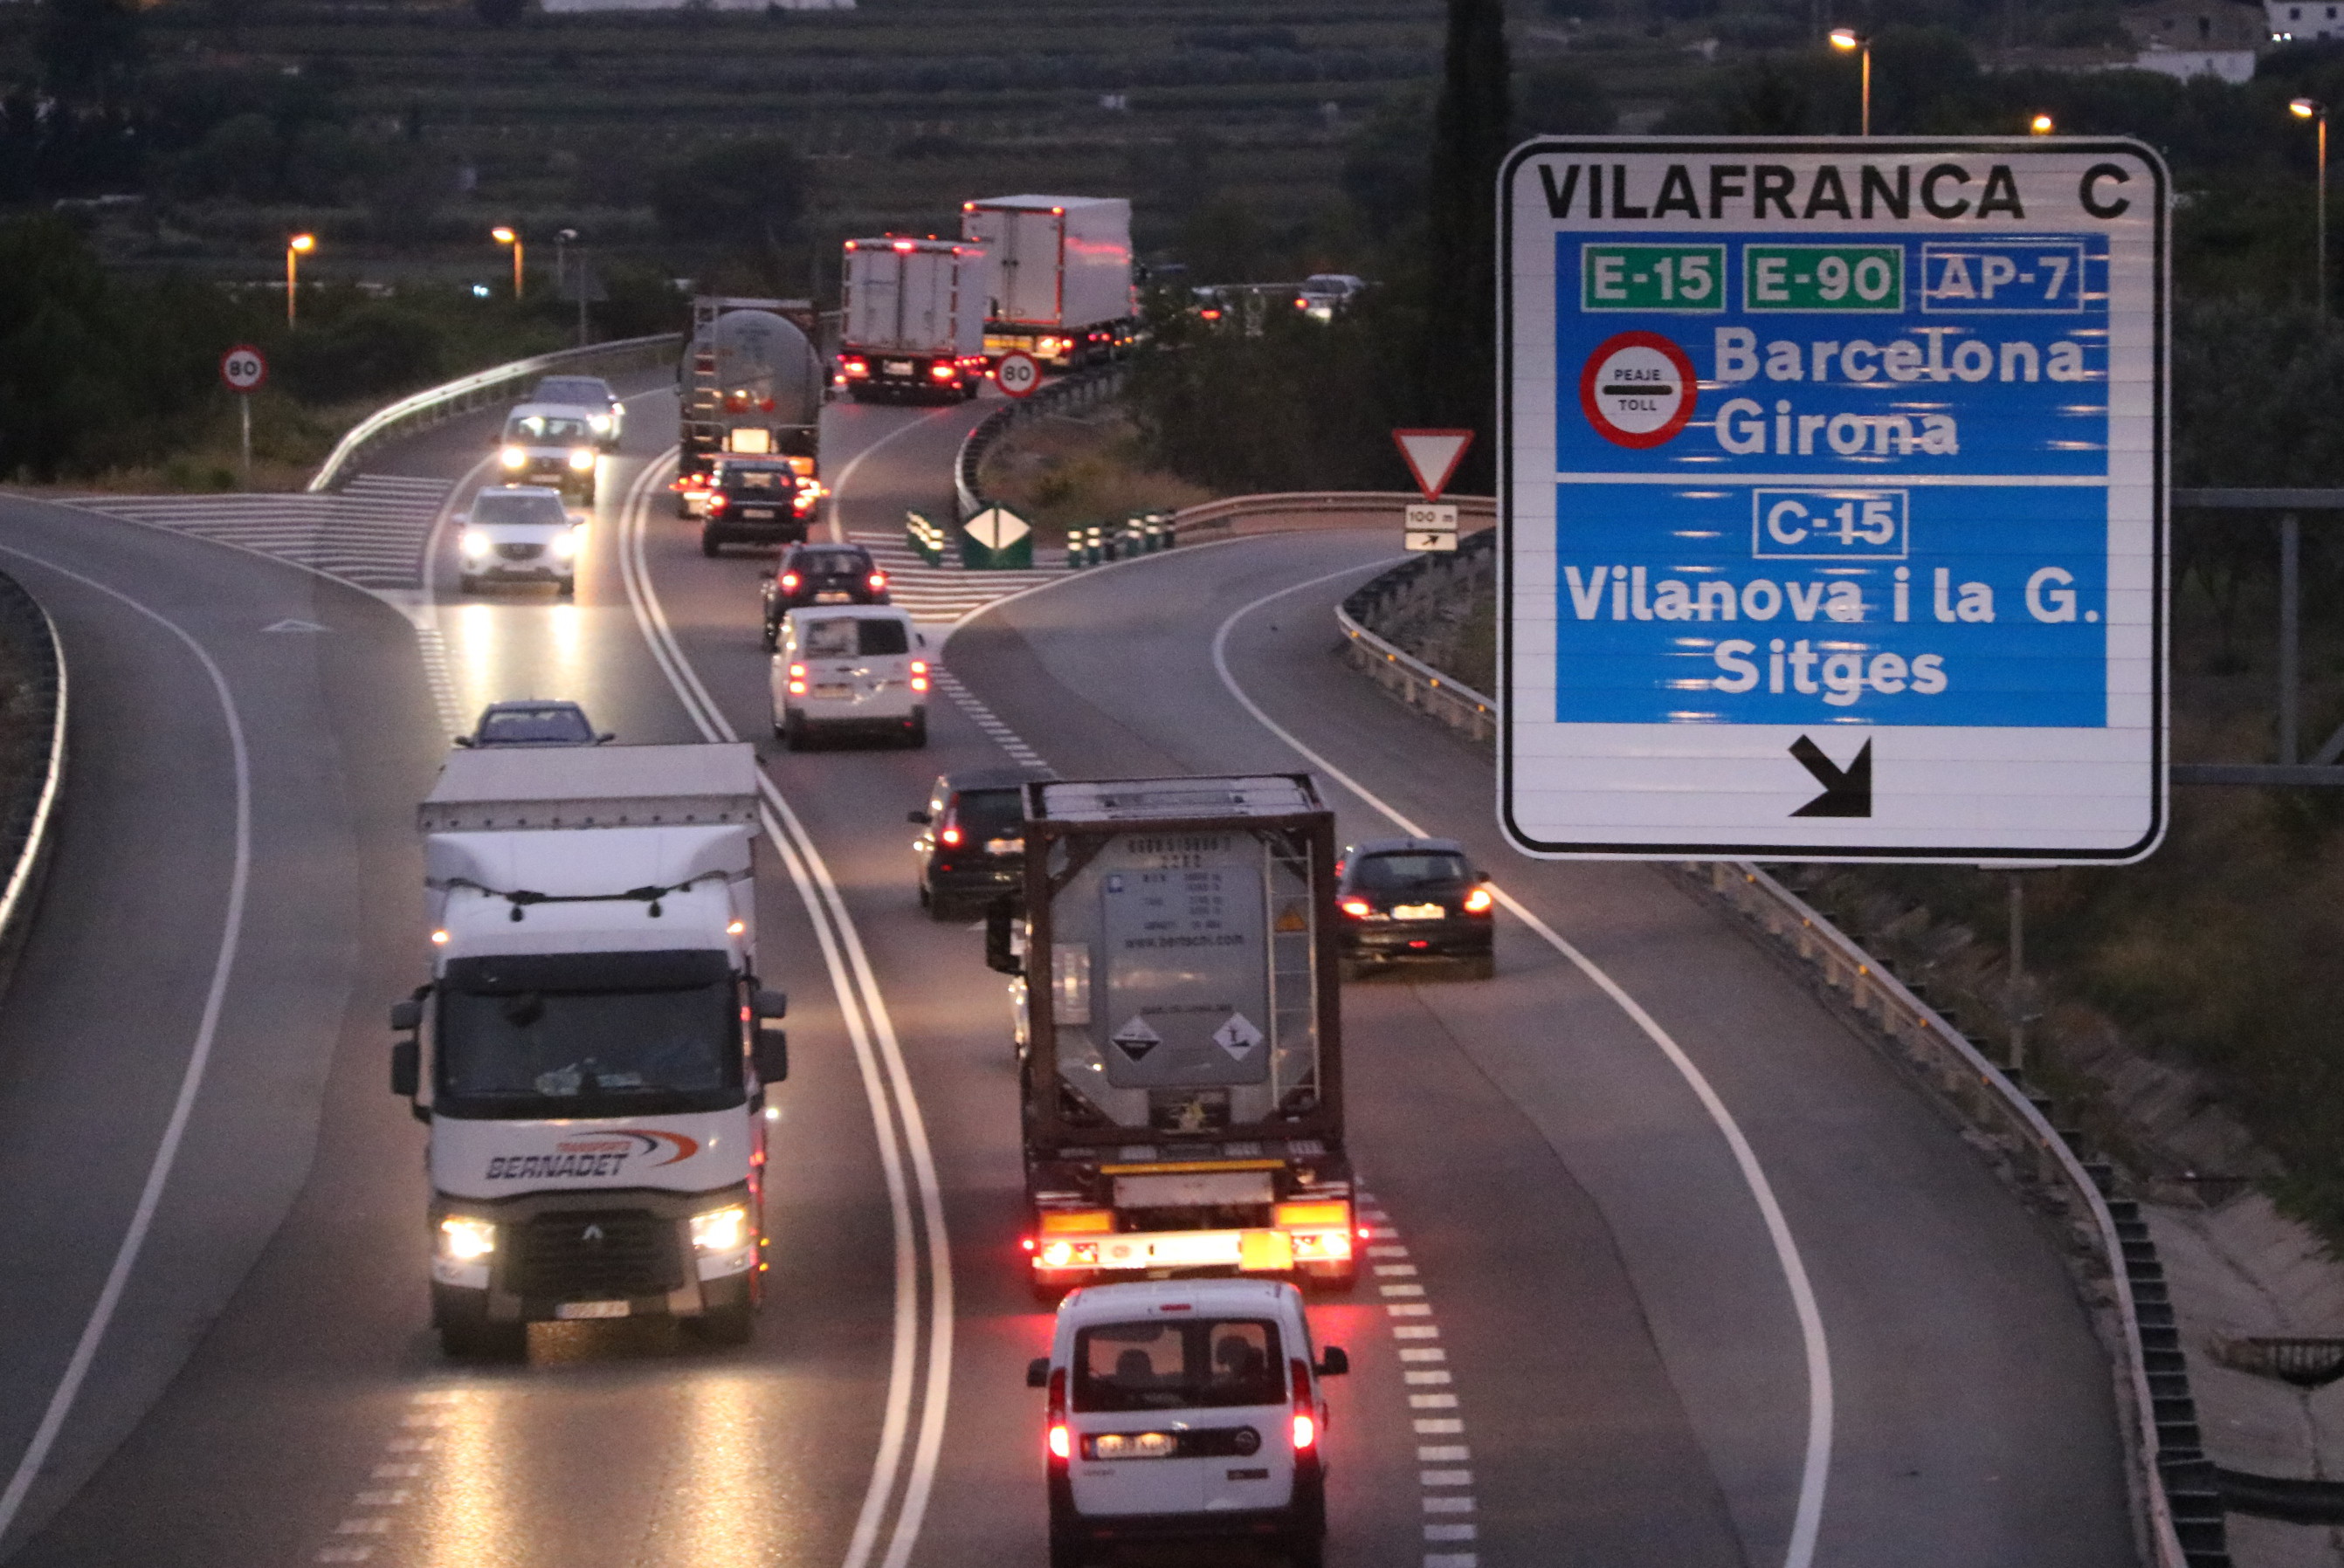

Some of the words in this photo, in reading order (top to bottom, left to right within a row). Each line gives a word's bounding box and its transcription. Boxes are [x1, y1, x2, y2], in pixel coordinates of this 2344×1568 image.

[1538, 164, 2025, 220] VILAFRANCA
[2079, 163, 2132, 220] C
[1594, 257, 1713, 299] E-15
[1756, 258, 1892, 301] E-90
[1939, 257, 2072, 300] AP-7
[230, 361, 257, 376] 80
[1003, 366, 1031, 382] 80
[1614, 368, 1661, 382] PEAJE
[1714, 327, 2085, 382] Barcelona
[1618, 399, 1658, 411] TOLL
[1714, 398, 1959, 455] Girona
[1409, 511, 1437, 522] 100
[1767, 500, 1895, 546] C-15
[1564, 566, 1863, 622] Vilanova
[1893, 567, 1911, 622] i
[1934, 567, 1996, 623] la
[2024, 567, 2100, 624] G.
[1713, 639, 1948, 706] Sitges
[485, 1152, 630, 1179] BERNADET
